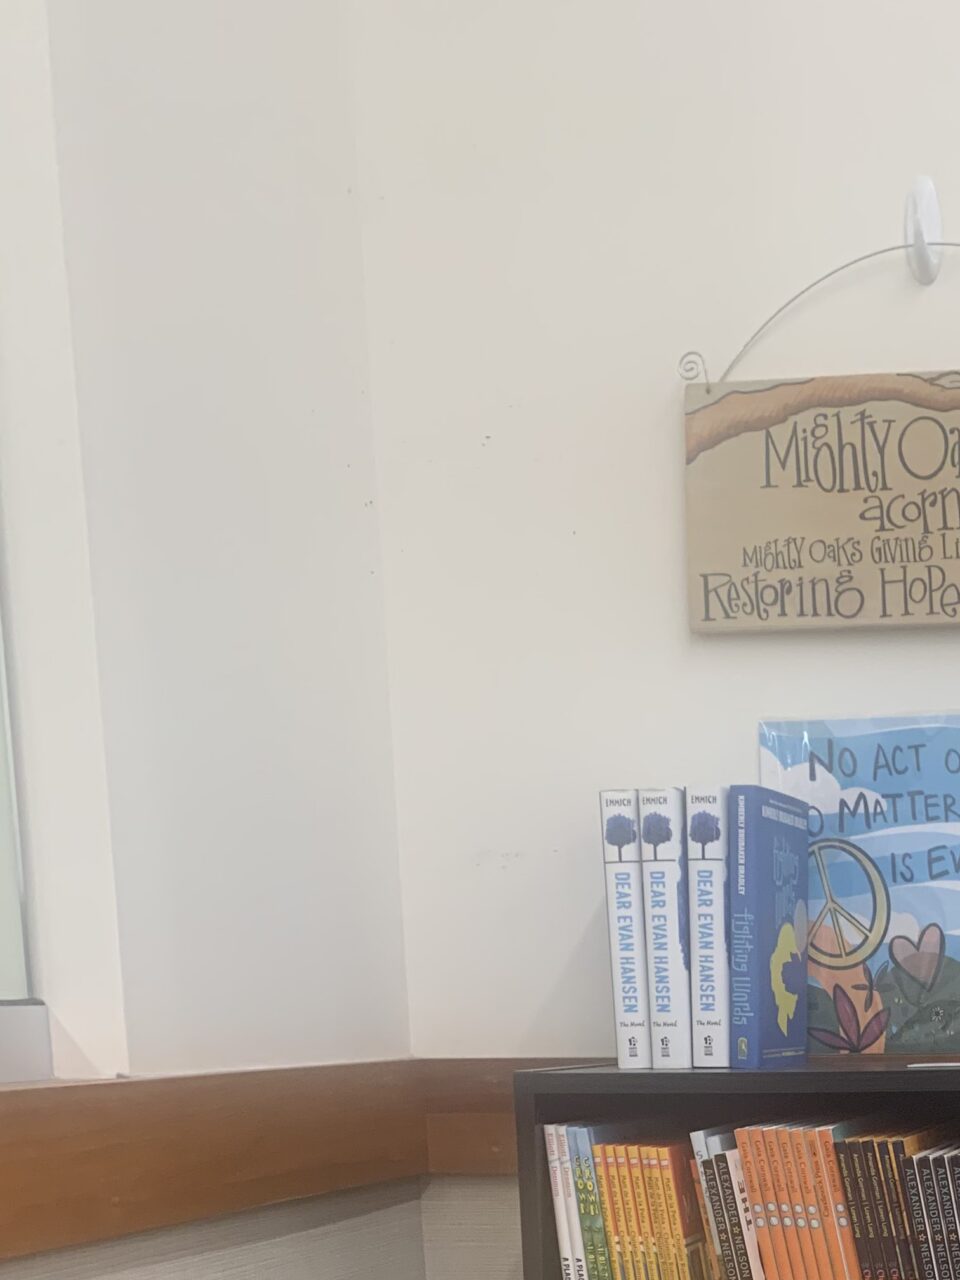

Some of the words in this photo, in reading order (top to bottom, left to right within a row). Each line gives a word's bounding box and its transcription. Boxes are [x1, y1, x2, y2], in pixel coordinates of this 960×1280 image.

[871, 533, 933, 565] Giving
[700, 569, 866, 622] Restoring
[807, 738, 857, 782] NO
[873, 742, 926, 776] ACT
[605, 799, 632, 807] EMMICH
[642, 797, 668, 805] EMMICH
[691, 796, 717, 804] EMMICH
[890, 852, 915, 884] IS
[614, 873, 633, 910] DEAR
[650, 871, 667, 909] DEAR
[697, 870, 713, 908] DEAR
[617, 915, 634, 952] EVAN
[651, 914, 668, 951] EVAN
[698, 913, 714, 950] EVAN
[620, 957, 639, 1013] HANSEN
[654, 956, 671, 1013] HANSEN
[698, 956, 715, 1011] HANSEN
[718, 1162, 739, 1224] ALEXANDER
[734, 1236, 751, 1278] NELSON
